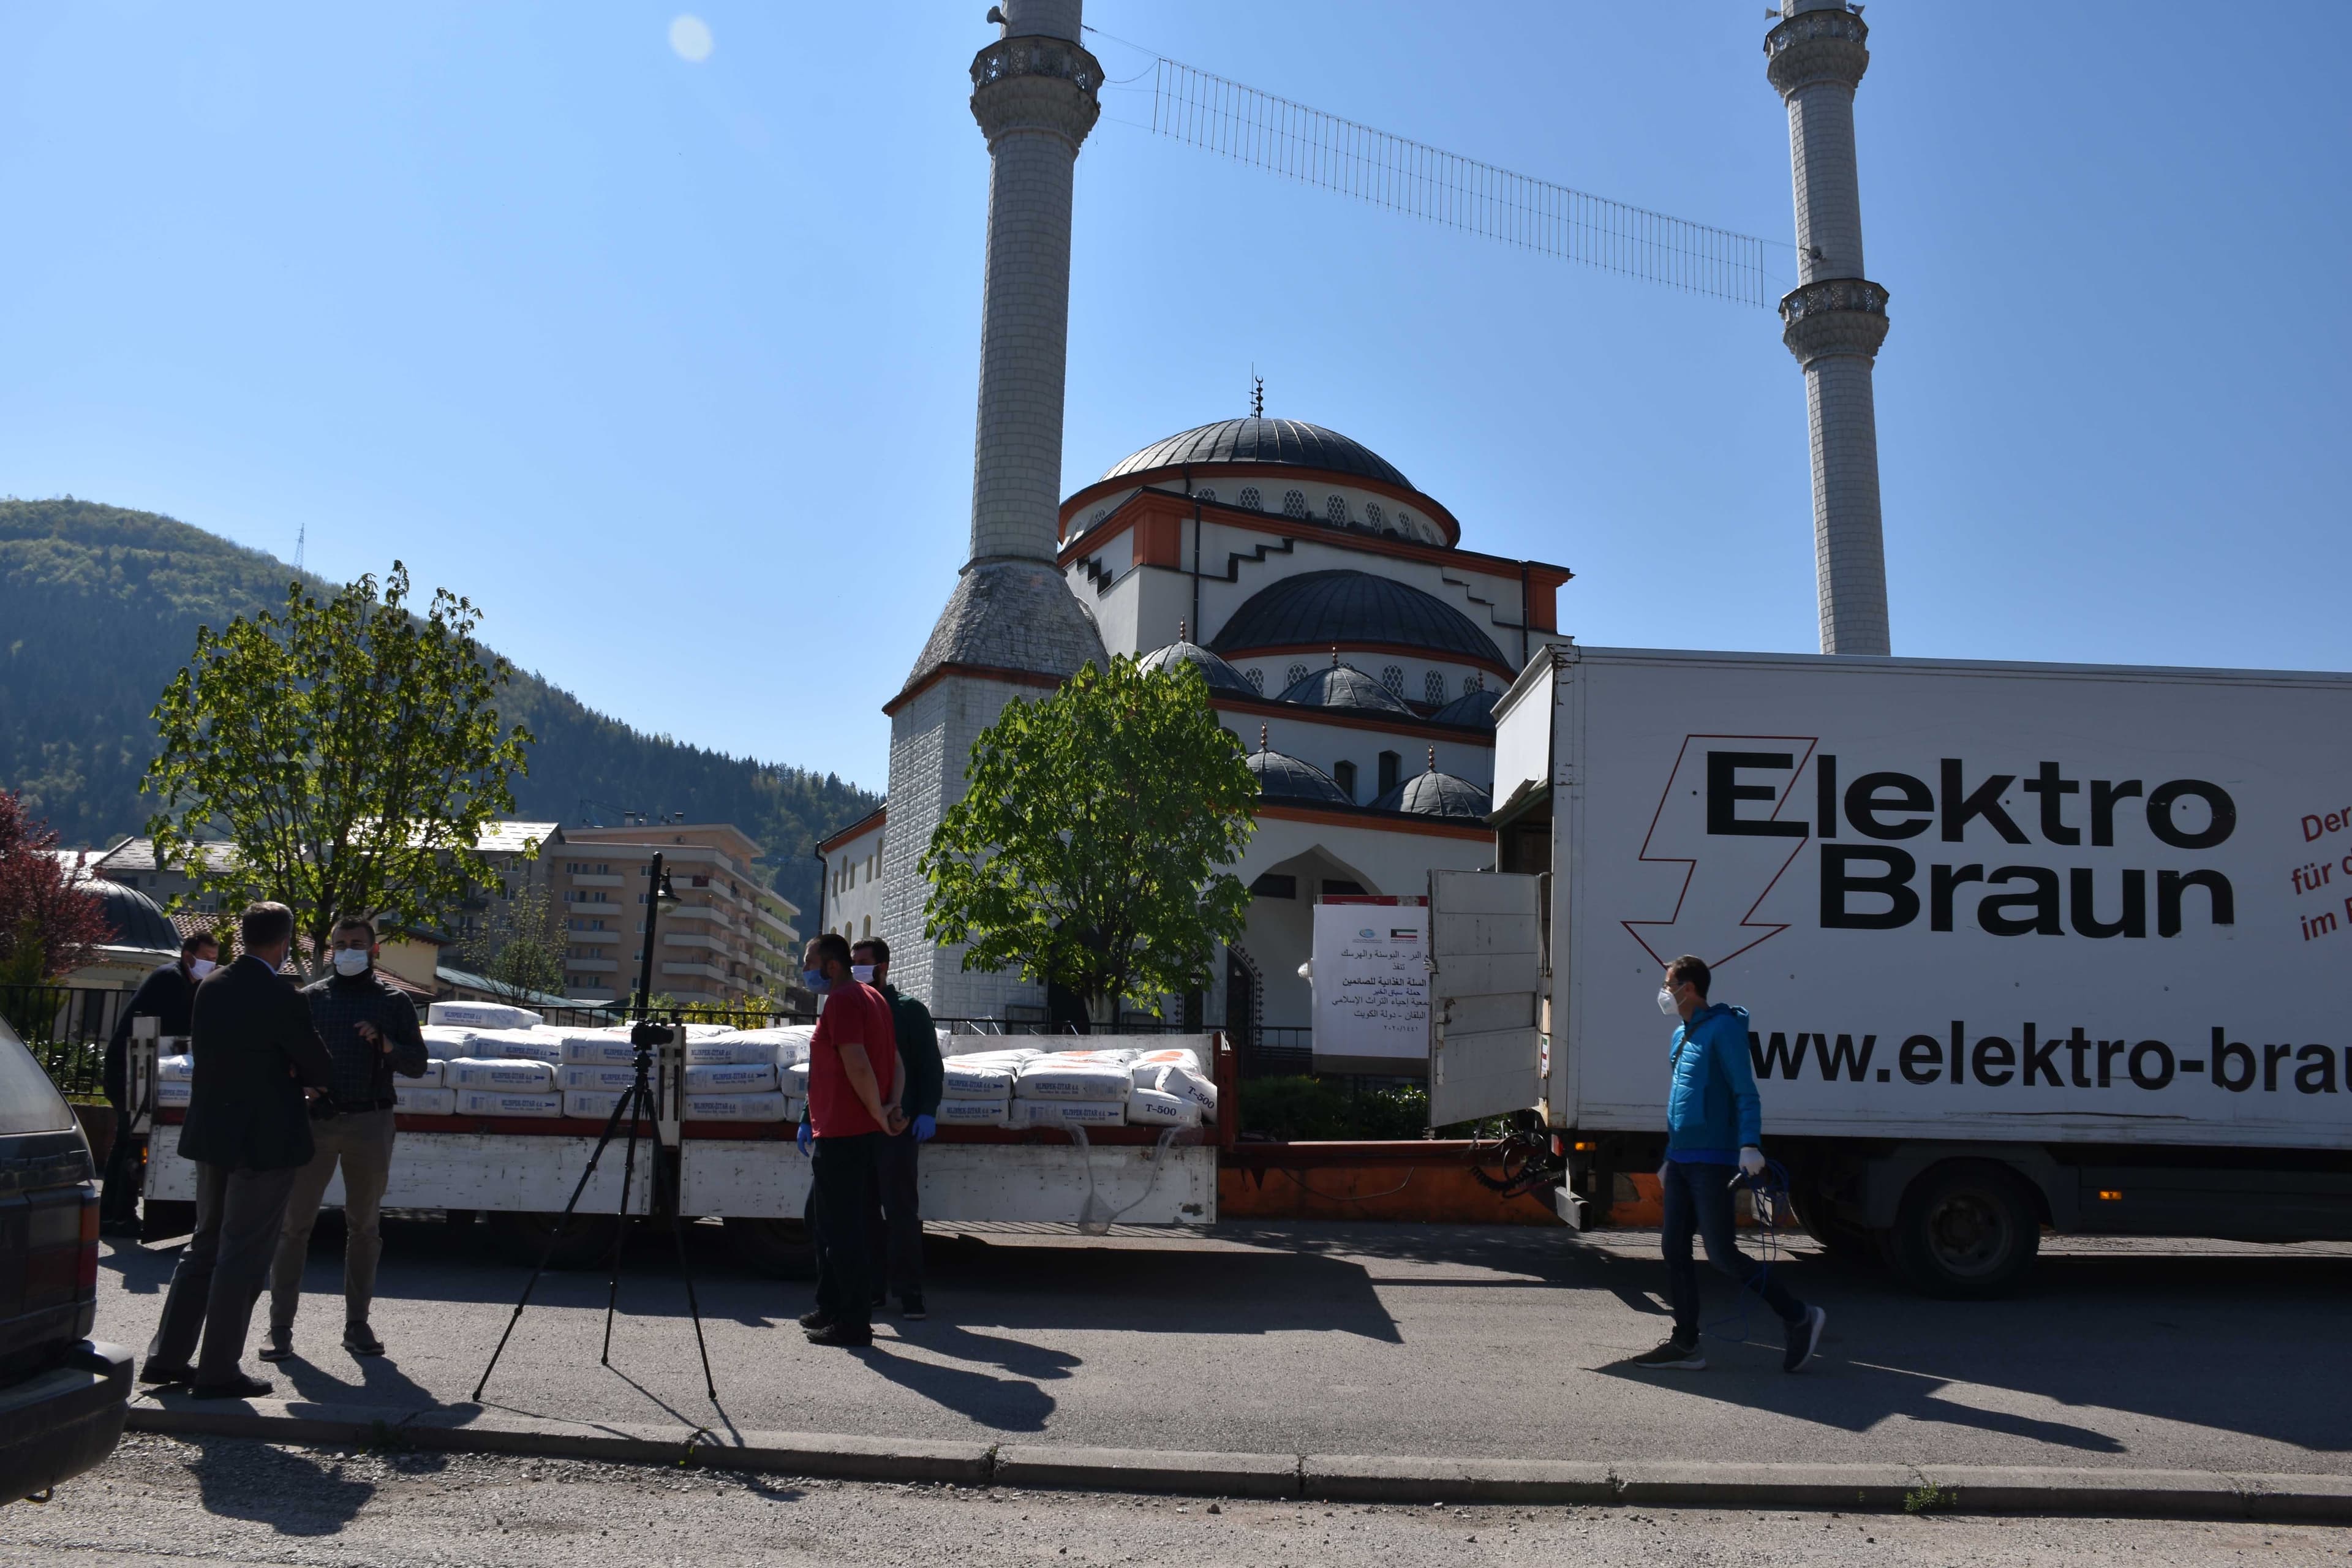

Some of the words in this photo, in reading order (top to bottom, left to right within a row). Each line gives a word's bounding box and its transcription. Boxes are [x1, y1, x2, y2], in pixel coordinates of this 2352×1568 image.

[1706, 750, 2237, 850] Elektro
[2301, 806, 2351, 842] Der
[2291, 862, 2332, 895] für
[1820, 843, 2236, 940] Braun
[2301, 912, 2337, 941] im
[1341, 949, 1372, 960] والهرسك
[1375, 950, 1399, 959] البوسنة
[1409, 951, 1422, 960] البر
[1407, 978, 1427, 987] السلة
[1365, 997, 1388, 1006] التراث
[1354, 1010, 1378, 1019] الكويت
[1381, 1011, 1396, 1020] دولة
[1405, 1011, 1426, 1021] البلقان
[1749, 1019, 2352, 1095] ww.elektro-bra
[1187, 1086, 1215, 1109] T-500
[1145, 1104, 1177, 1116] T-500
